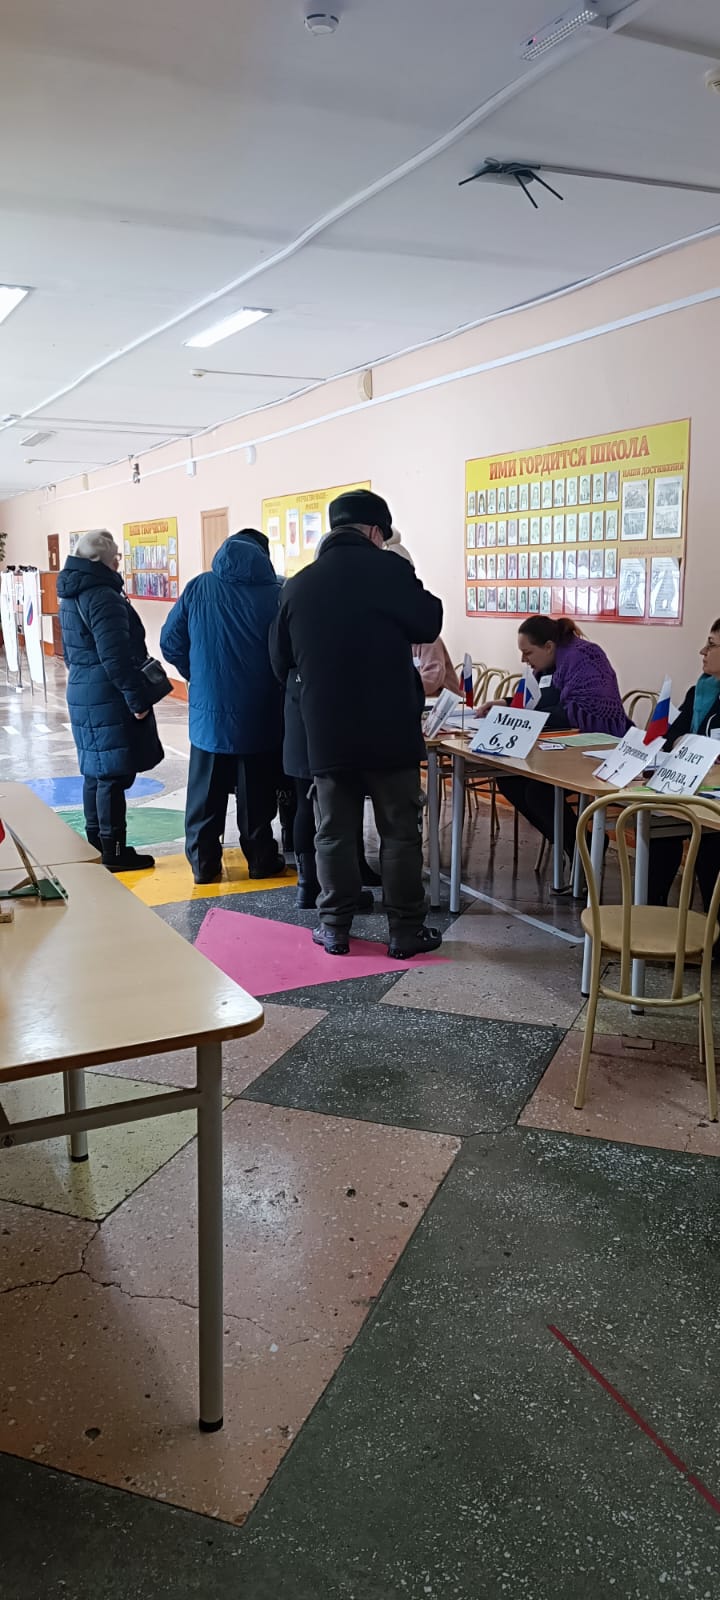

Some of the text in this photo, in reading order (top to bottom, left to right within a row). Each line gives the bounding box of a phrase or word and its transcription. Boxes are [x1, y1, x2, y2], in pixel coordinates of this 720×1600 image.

[489, 435, 650, 480] ИМИ ГОРДИТСЯ ШКОЛА
[494, 712, 532, 730] Мира,
[505, 735, 518, 749] 8
[687, 751, 704, 765] лет
[689, 774, 698, 788] 1
